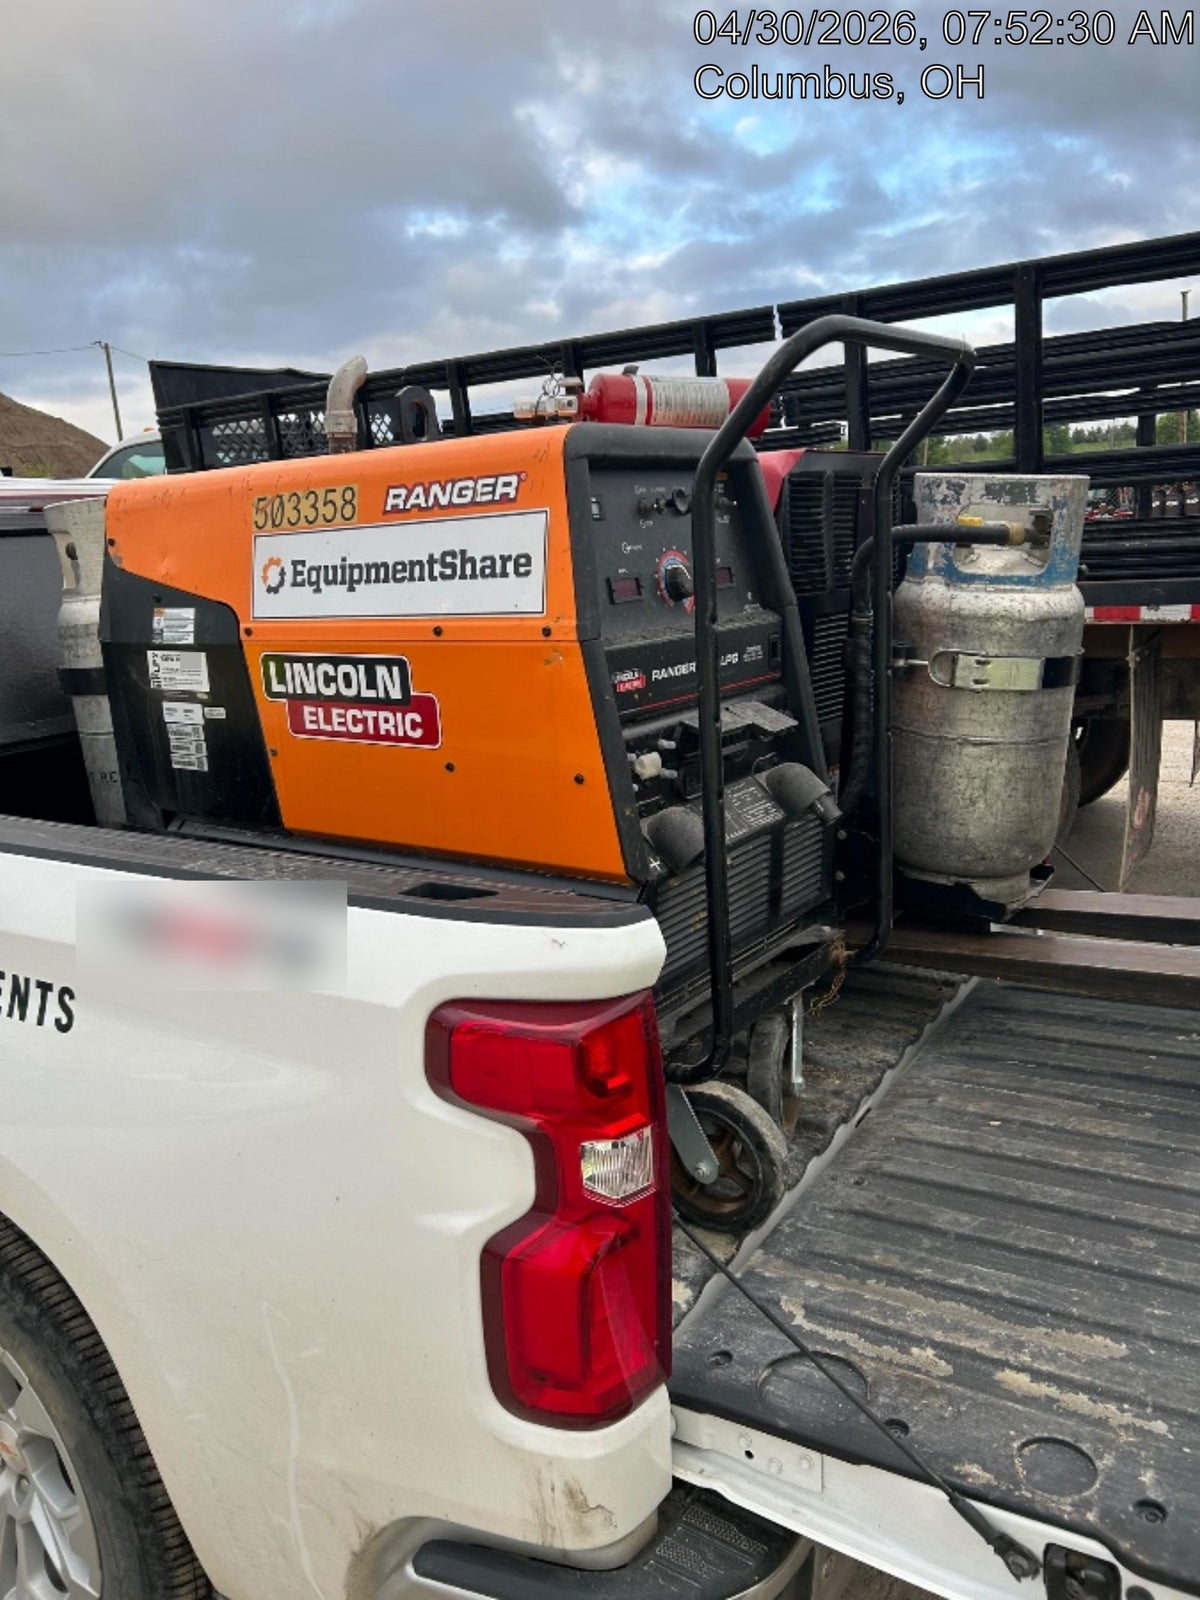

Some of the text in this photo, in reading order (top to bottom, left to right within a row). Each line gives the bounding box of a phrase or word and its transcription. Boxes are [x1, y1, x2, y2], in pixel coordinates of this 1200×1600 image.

[253, 486, 357, 530] 503358
[383, 473, 519, 513] RANGER
[290, 549, 532, 593] EquipmentShare
[268, 660, 403, 700] LINCOLN
[302, 705, 424, 738] ELECTRIC
